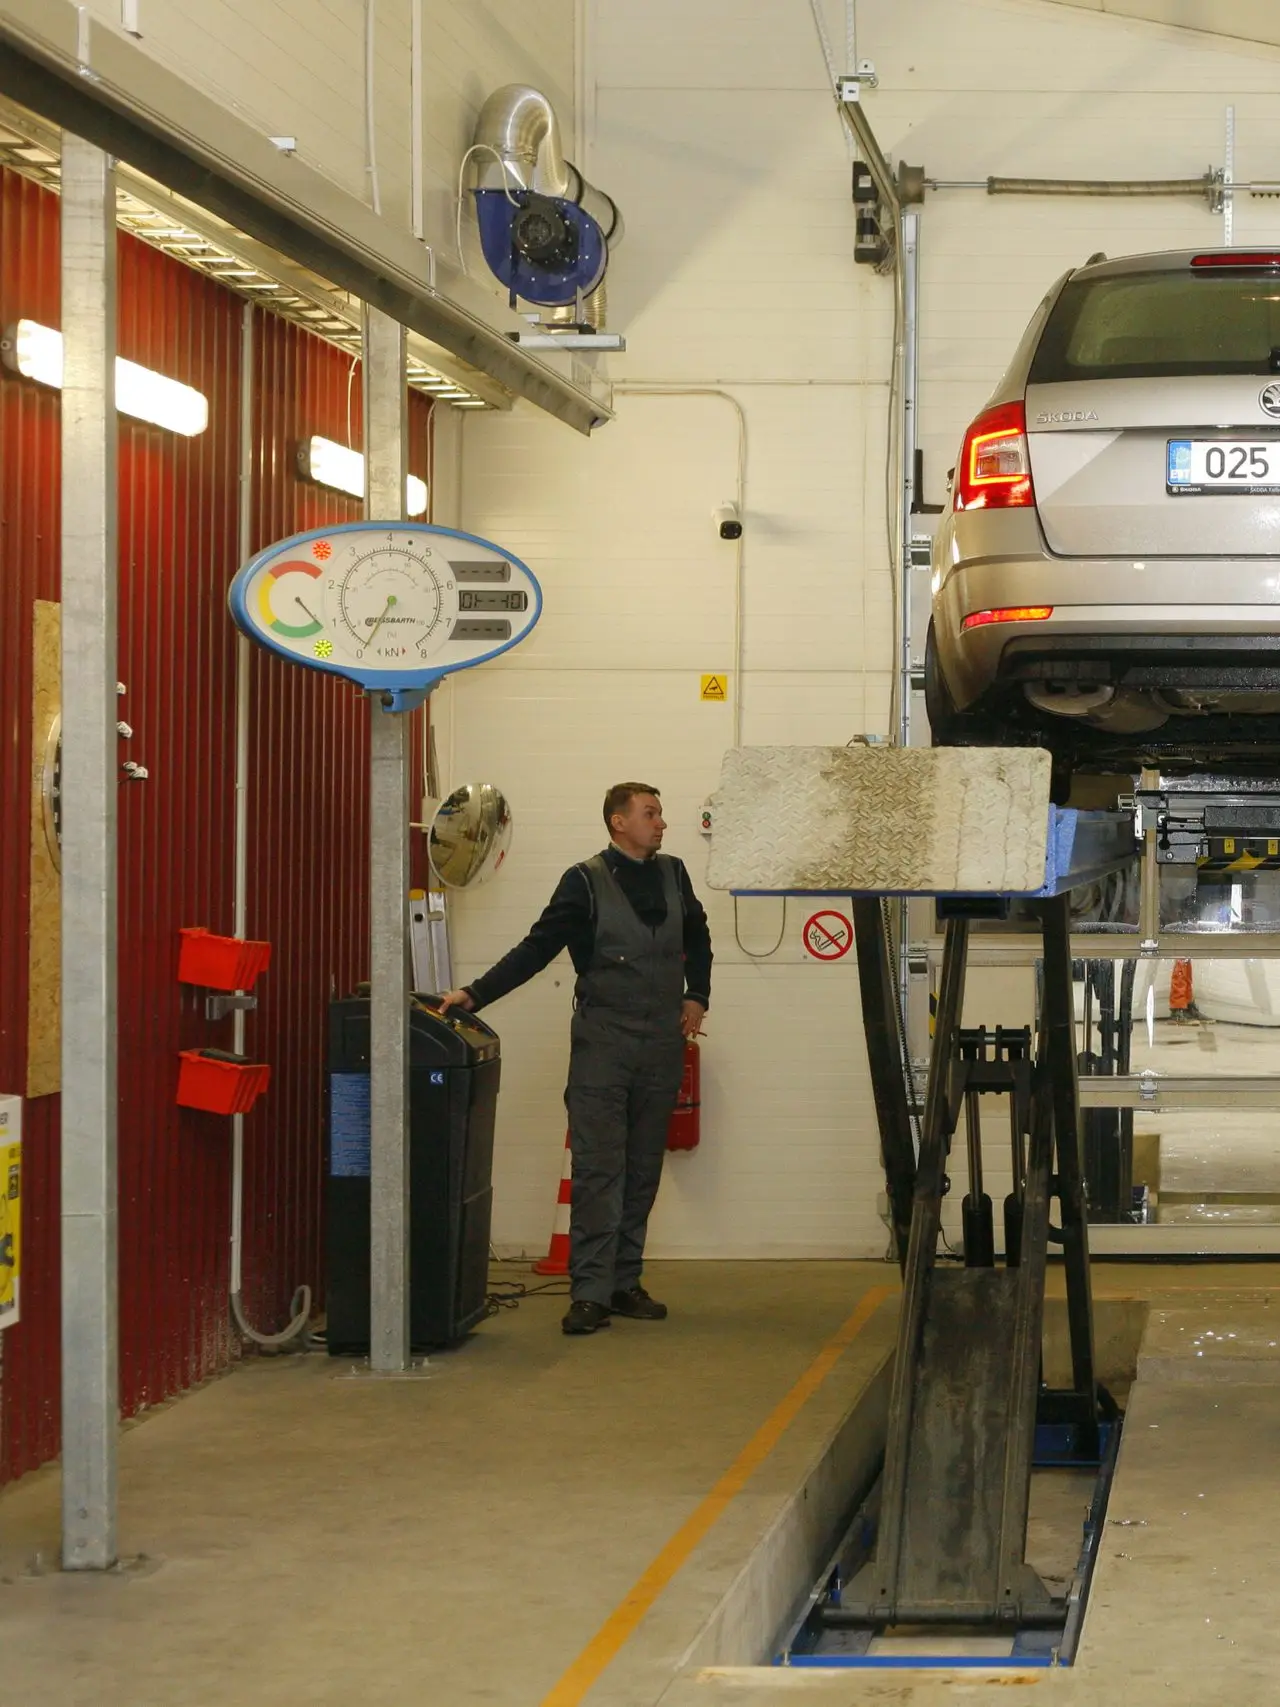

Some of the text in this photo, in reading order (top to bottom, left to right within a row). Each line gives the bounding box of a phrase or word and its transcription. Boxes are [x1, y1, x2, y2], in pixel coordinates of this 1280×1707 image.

[1205, 446, 1269, 479] 025
[386, 532, 393, 542] 4
[349, 546, 356, 556] 3
[425, 547, 432, 557] 5
[328, 579, 335, 590] 2
[446, 580, 453, 590] 6
[331, 617, 337, 627] 1
[445, 617, 452, 628] 7
[356, 648, 363, 659] 0
[384, 647, 399, 657] kN
[420, 648, 427, 659] 8
